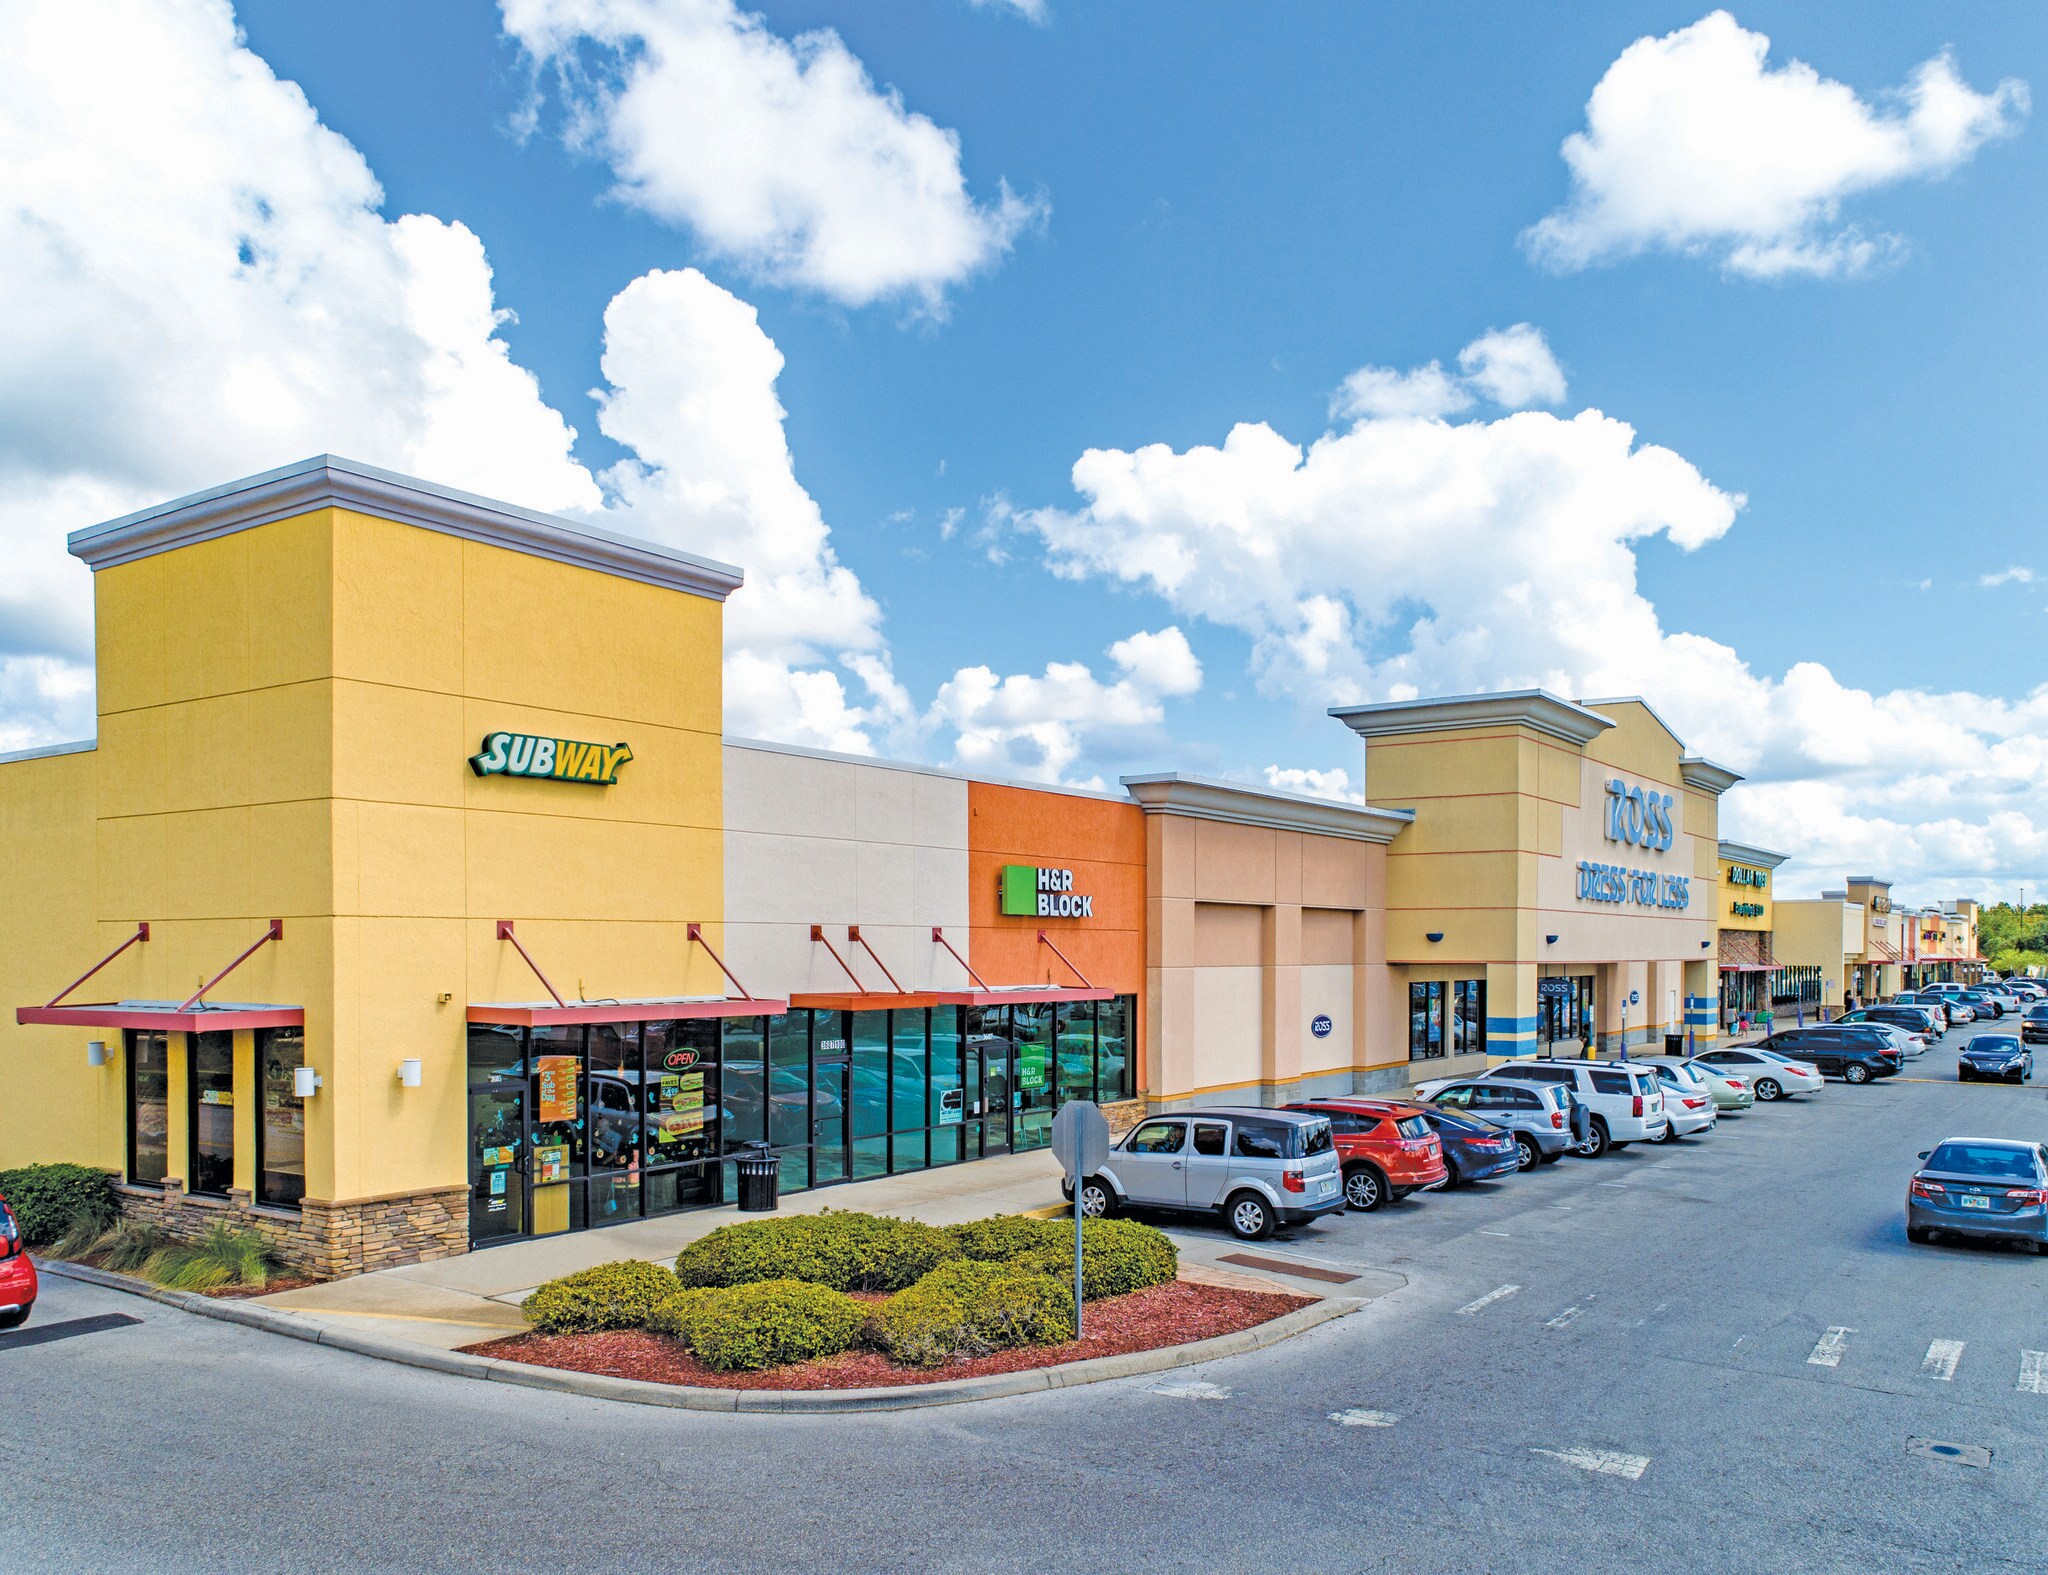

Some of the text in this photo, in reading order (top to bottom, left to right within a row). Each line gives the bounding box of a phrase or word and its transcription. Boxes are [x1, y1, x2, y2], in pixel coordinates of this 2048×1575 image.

[478, 733, 633, 781] SUBWAY
[1605, 779, 1673, 851] ROSS
[1037, 867, 1074, 892] H&R
[1576, 861, 1689, 909] DRESS FOR LESS
[1037, 893, 1094, 918] BLOCK
[1540, 983, 1569, 993] ROSS
[1314, 1020, 1330, 1031] ROSS
[667, 1053, 695, 1066] OPEN
[1021, 1067, 1036, 1076] H&R
[541, 1081, 555, 1089] Sub
[1021, 1076, 1043, 1086] BLOCK
[541, 1093, 555, 1102] Day
